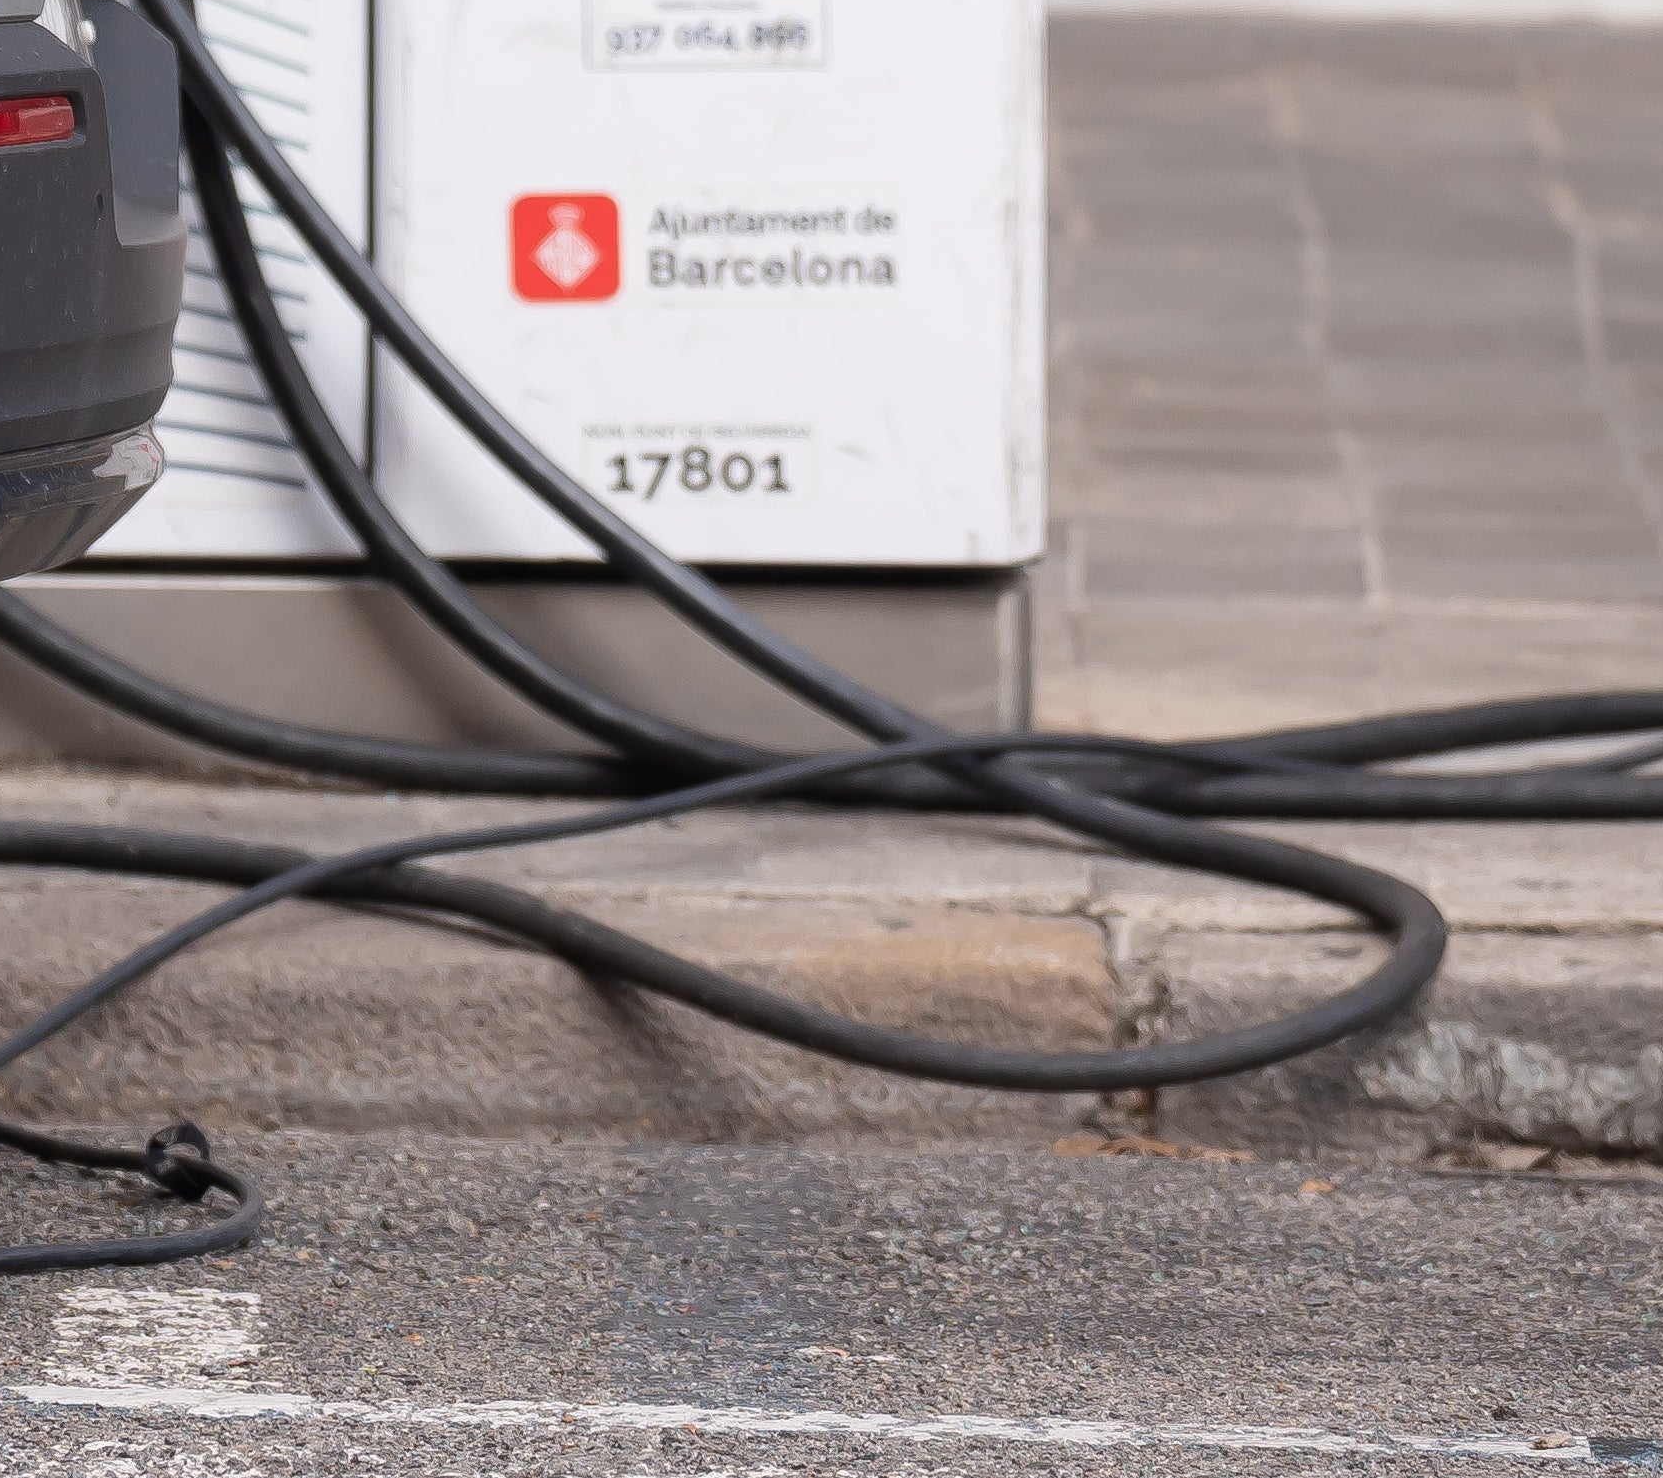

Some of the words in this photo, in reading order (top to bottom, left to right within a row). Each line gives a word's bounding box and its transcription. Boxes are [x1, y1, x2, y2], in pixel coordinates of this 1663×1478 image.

[648, 206, 846, 242] Ajuntament
[853, 204, 898, 235] de
[647, 246, 897, 287] Barcelona
[604, 445, 794, 501] 17801
